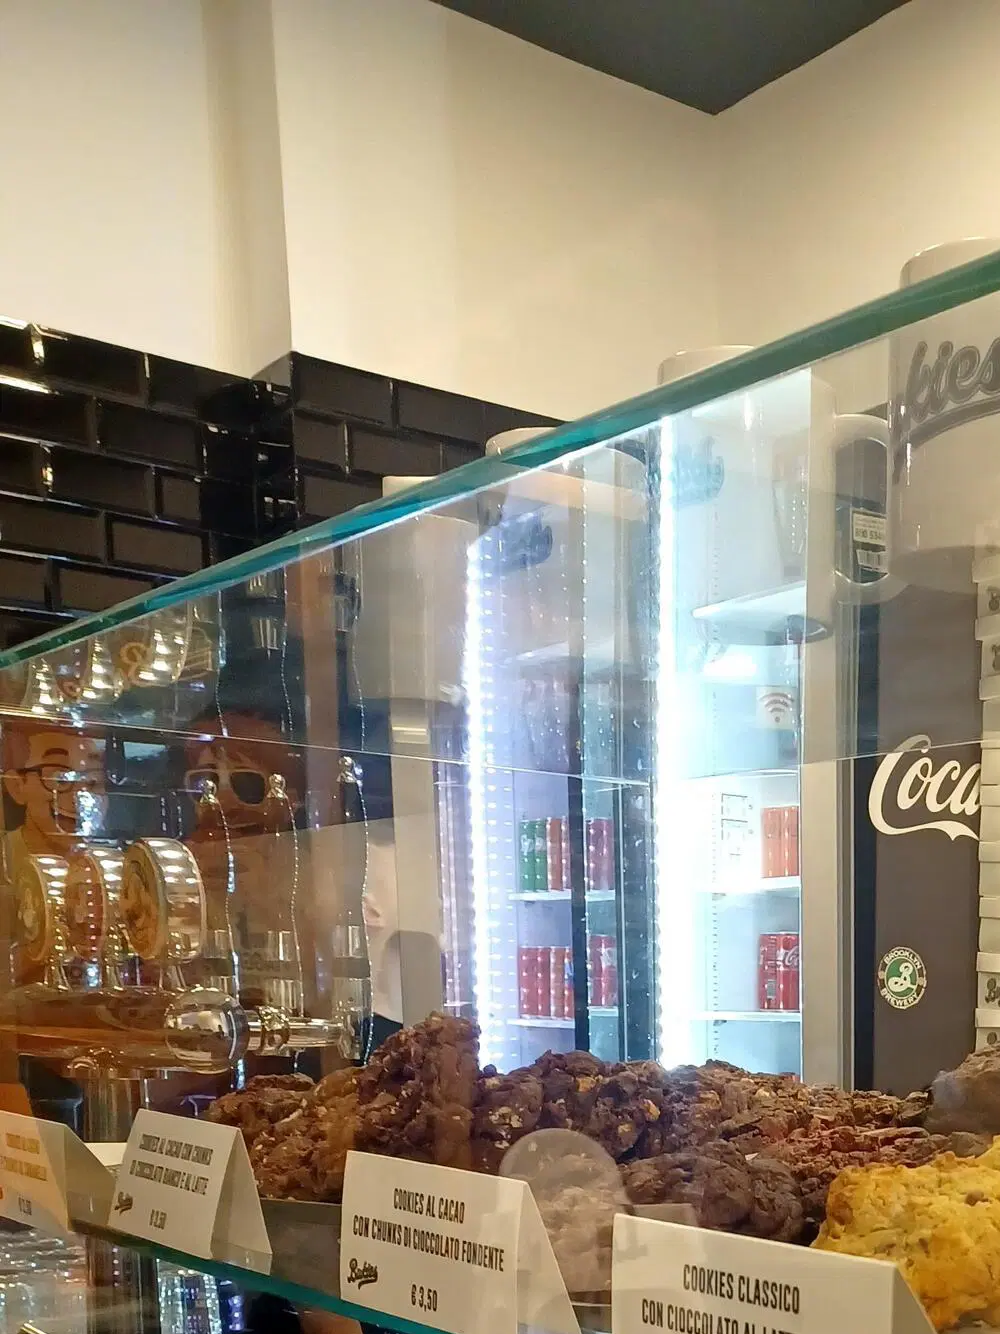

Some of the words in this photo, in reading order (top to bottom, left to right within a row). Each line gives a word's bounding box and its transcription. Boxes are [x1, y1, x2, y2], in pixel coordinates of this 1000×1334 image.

[394, 1187, 424, 1215] COOKIES
[426, 1194, 436, 1217] AL
[438, 1197, 465, 1224] CACAO
[353, 1214, 369, 1238] CON
[371, 1219, 402, 1246] CHUNKS
[403, 1225, 411, 1248] DI
[413, 1228, 459, 1261] CIOCCOLATO
[462, 1240, 505, 1272] FONDENTE
[411, 1284, 417, 1306] €
[418, 1286, 438, 1312] 3,50
[683, 1264, 734, 1300] COOKIES
[738, 1275, 800, 1315] CLASSICO
[641, 1298, 663, 1328] CON
